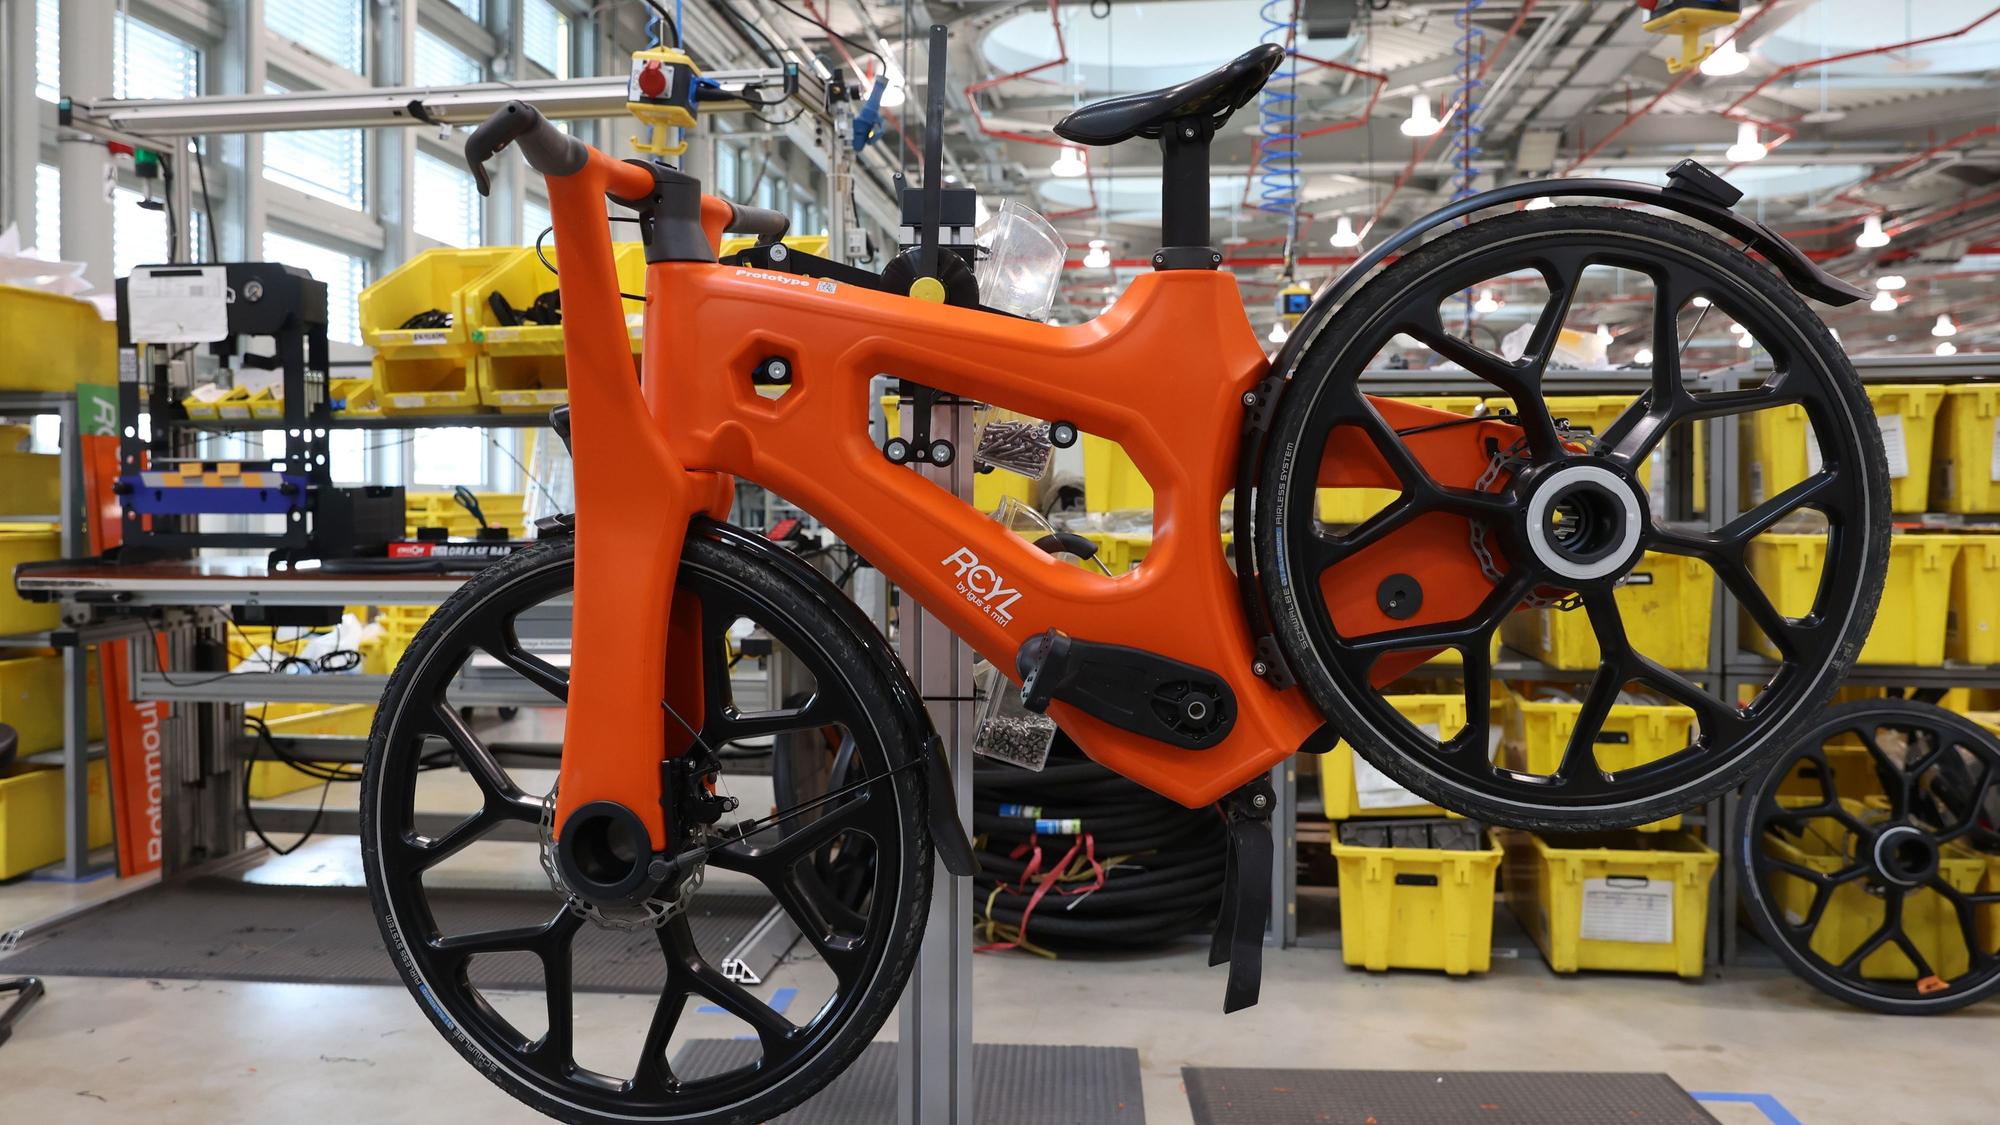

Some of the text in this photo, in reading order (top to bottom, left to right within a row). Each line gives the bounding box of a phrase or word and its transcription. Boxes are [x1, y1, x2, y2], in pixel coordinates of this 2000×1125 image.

[735, 268, 810, 287] Prototype
[1280, 442, 1294, 481] SYSTEM
[1275, 483, 1286, 525] AIRLESS
[448, 546, 488, 556] GREASE
[490, 546, 511, 556] BAR
[956, 581, 1009, 628] by igus & mtrl
[1283, 588, 1308, 649] SCHWALBE
[385, 914, 403, 950] SYSTEM
[400, 950, 422, 985] AIRLESS
[453, 1028, 498, 1072] SCHWALBE
